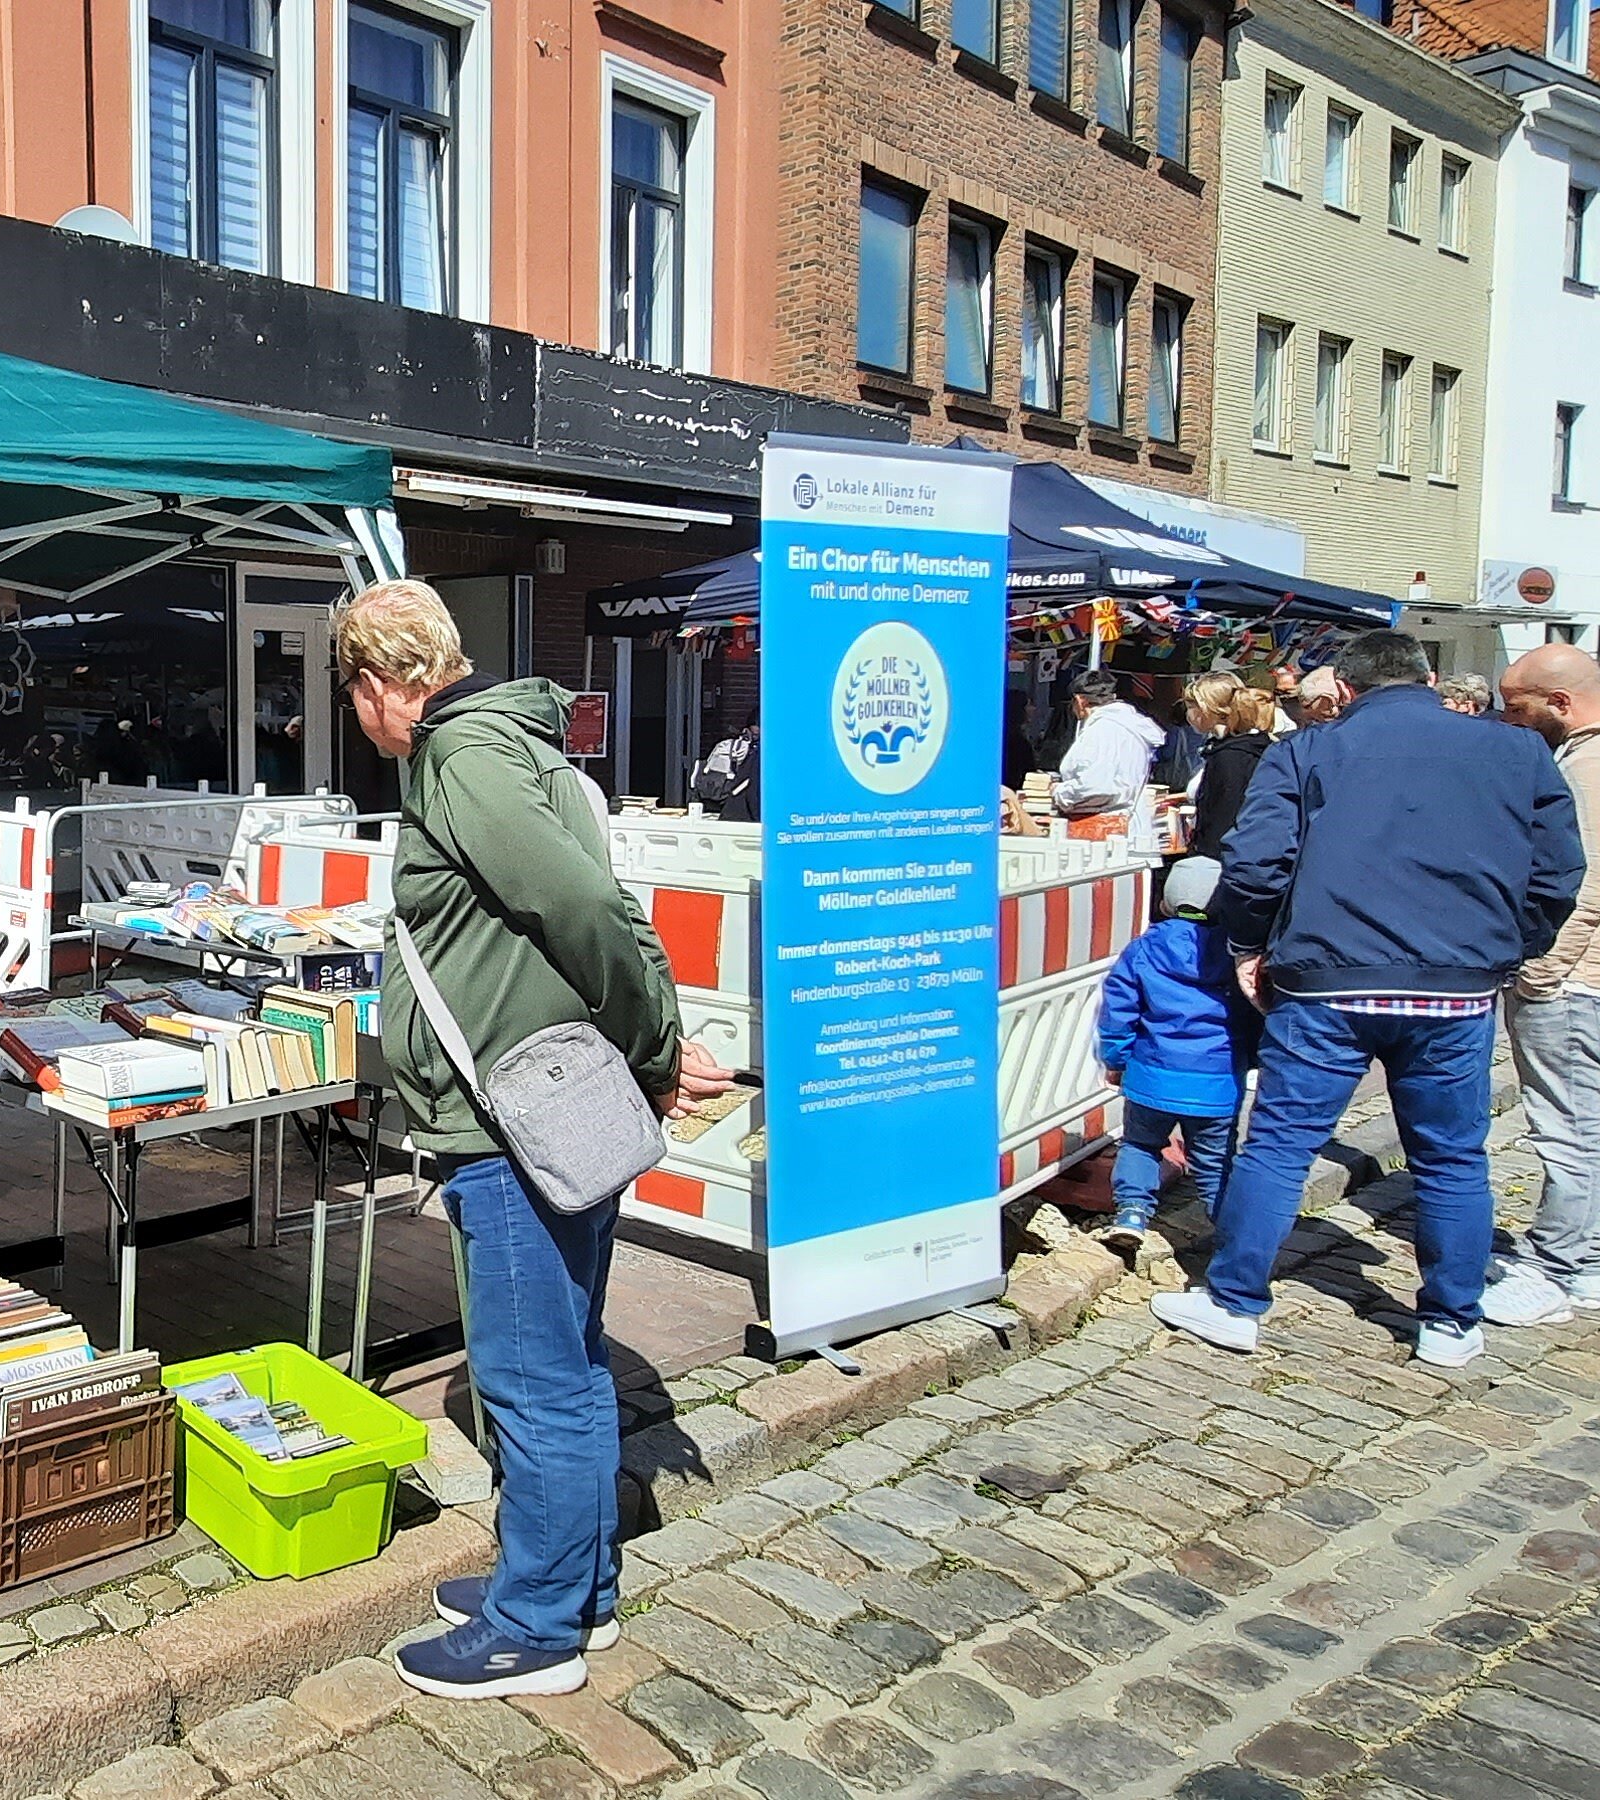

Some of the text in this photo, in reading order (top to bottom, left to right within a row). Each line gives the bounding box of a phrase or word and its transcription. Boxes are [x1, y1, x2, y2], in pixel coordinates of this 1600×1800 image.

[826, 478, 937, 501] Lokale Allianz für
[826, 500, 935, 517] Menschen mit Demenz
[788, 546, 990, 579] Ein Chor für Menschen
[810, 580, 970, 605] mit und ohne Demenz
[1006, 572, 1086, 587] ikes.com
[881, 656, 898, 674] DIE
[866, 674, 911, 697] MÖLLNER
[857, 699, 918, 720] GOLDKEHLEN
[790, 814, 805, 826] Sie
[805, 811, 850, 827] und/oder
[871, 809, 929, 822] Angehörigen
[929, 808, 959, 822] singen
[776, 820, 994, 845] Sie wollen zusammen mit anderen Leuten singen?
[803, 859, 973, 888] Dann kommen Sie zu den
[818, 884, 957, 911] Möllner Goldkehlen!
[777, 924, 994, 961] Immer donnerstags 9:45 bis 11:30 Uhr
[834, 950, 942, 977] Robert-Koch-Park
[334, 965, 347, 992] WI
[791, 966, 984, 1004] Hindenburgstraße 13 23879 Mölln
[821, 1017, 878, 1037] Anmeldung
[879, 1013, 899, 1029] und
[815, 1025, 960, 1056] Koordinierungsstelle Demenz
[799, 1056, 976, 1096] info@koordinierungsstelle-demenz.de
[839, 1056, 857, 1070] Tel.
[799, 1073, 976, 1115] www.koordinierungsstelle-demenz.de
[6, 1351, 85, 1382] MOSSMANN
[30, 1391, 68, 1414] IVAN
[70, 1373, 142, 1404] REBROFF
